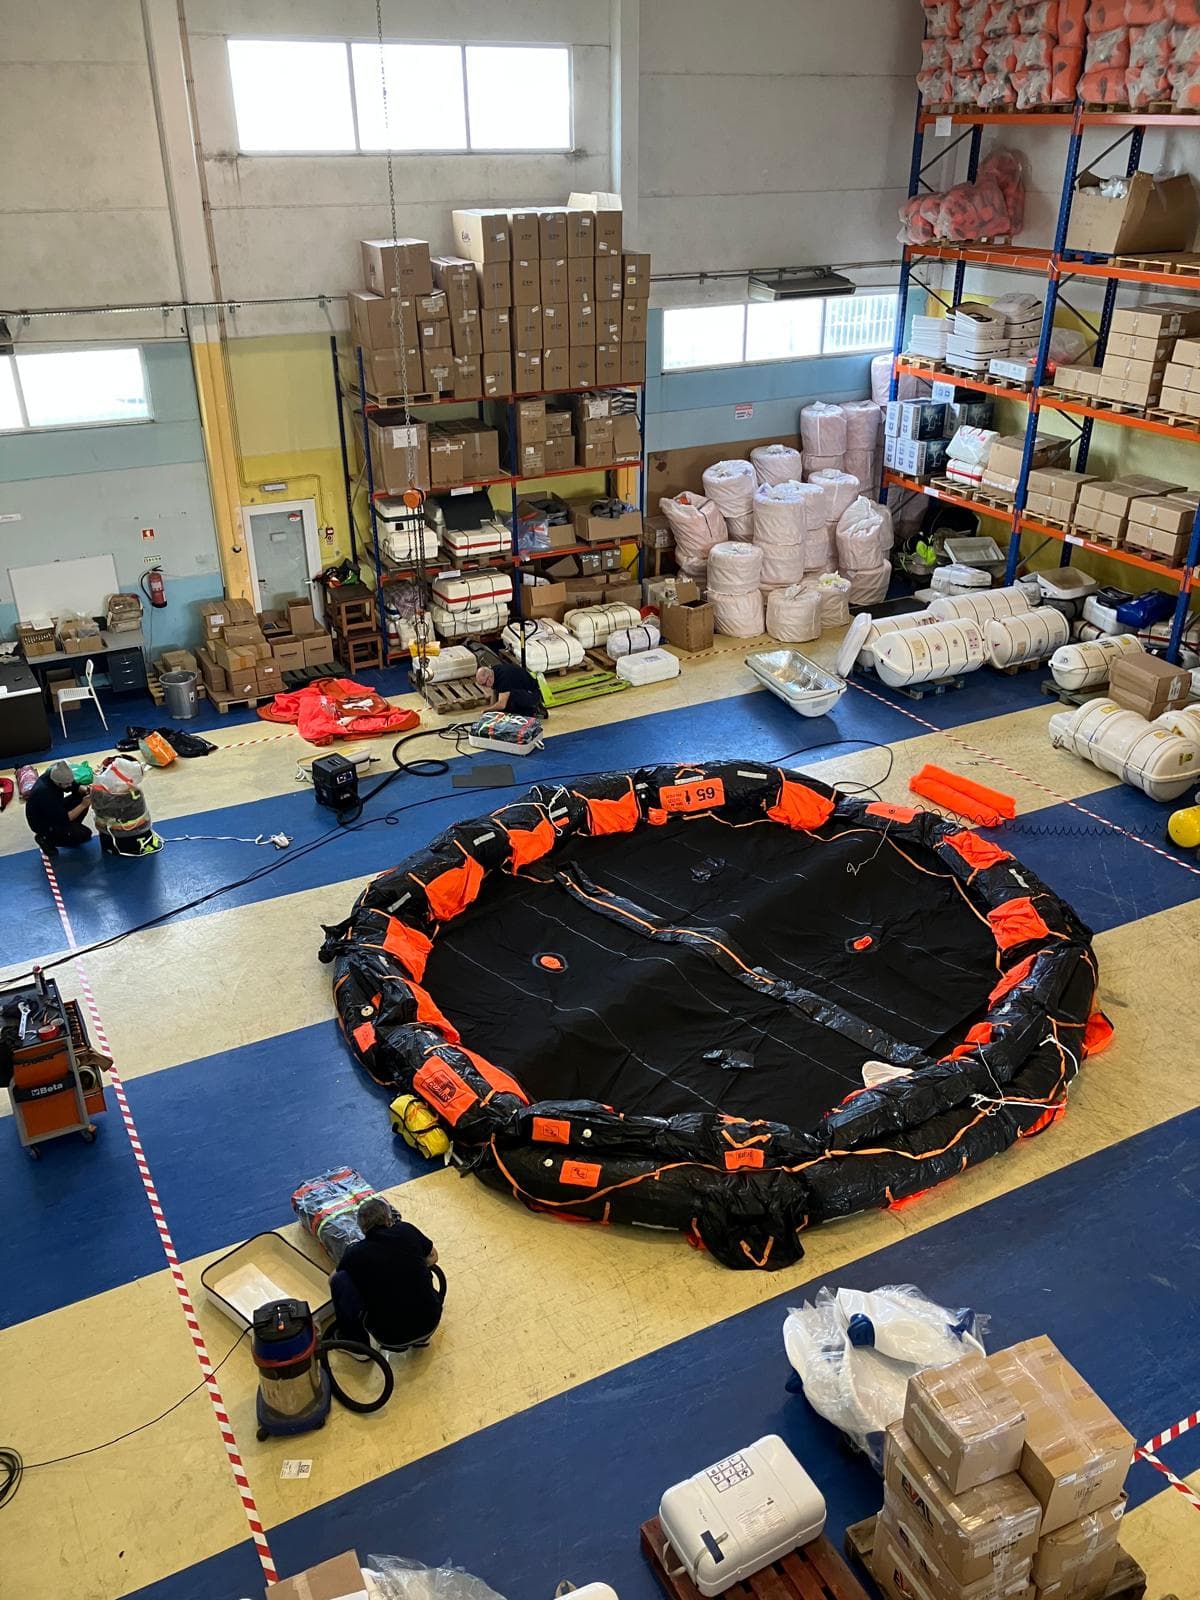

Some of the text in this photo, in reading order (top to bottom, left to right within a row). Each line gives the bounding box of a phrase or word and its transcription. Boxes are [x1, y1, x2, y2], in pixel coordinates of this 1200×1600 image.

[696, 787, 715, 801] 65
[40, 1083, 62, 1094] Beta
[901, 1474, 934, 1528] EVAL
